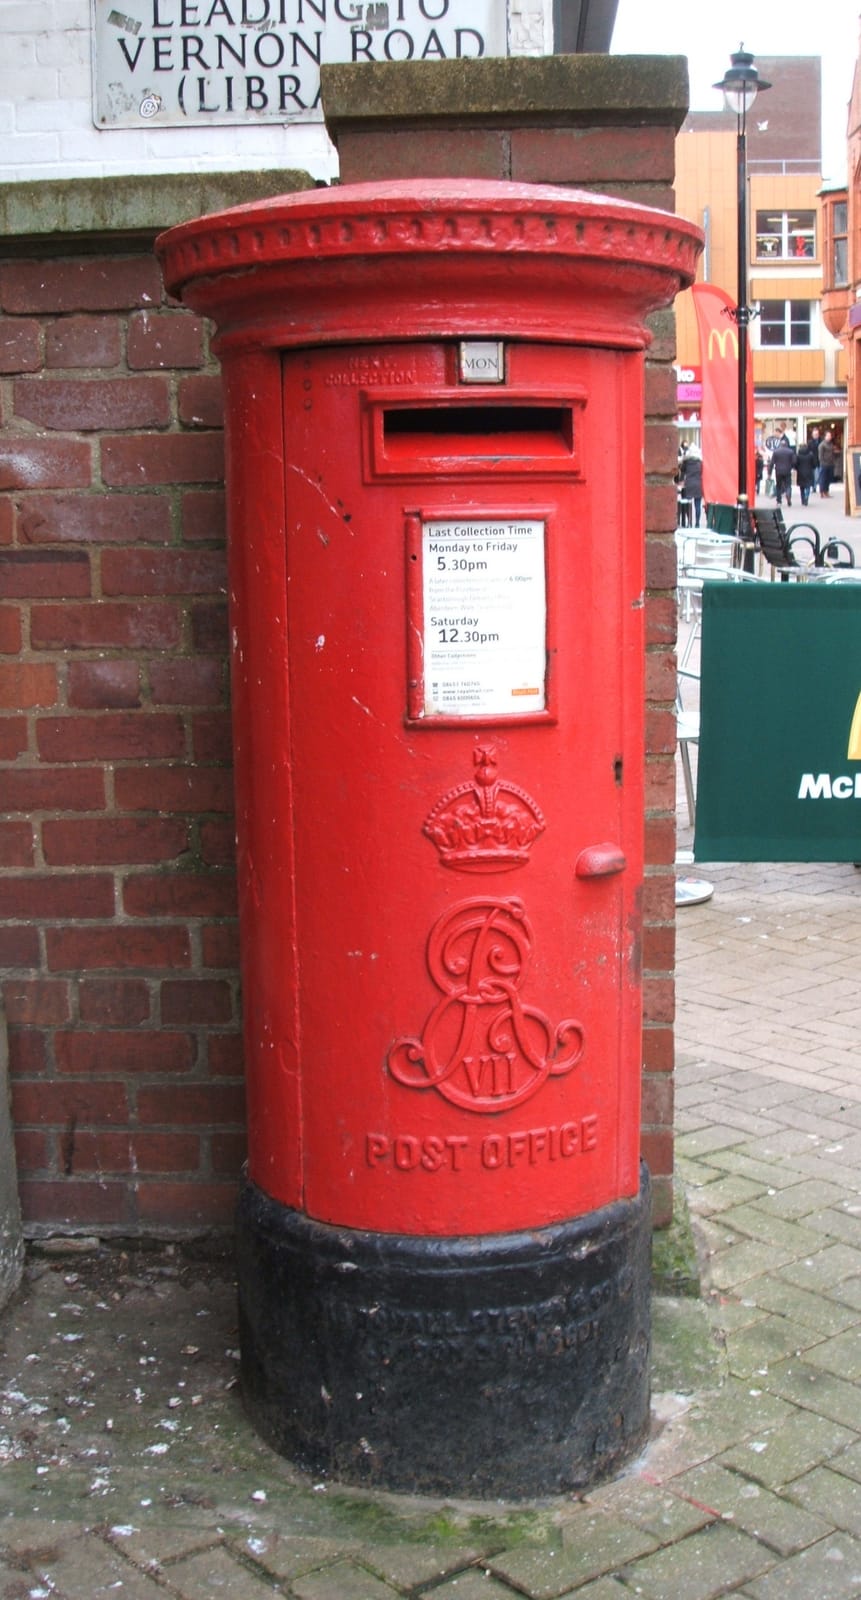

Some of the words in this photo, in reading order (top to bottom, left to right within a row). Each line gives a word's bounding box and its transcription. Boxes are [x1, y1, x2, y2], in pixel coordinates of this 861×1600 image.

[152, 0, 364, 28] LEADING
[117, 31, 321, 73] VERNON
[350, 28, 485, 61] ROAD
[463, 357, 499, 370] MON
[326, 369, 417, 386] COLLECTION
[789, 399, 831, 409] Edinburgh
[428, 527, 451, 538] Last
[454, 526, 505, 537] Collection
[508, 525, 533, 535] Time
[429, 543, 471, 555] Monday
[472, 543, 483, 552] to
[486, 542, 518, 554] Friday
[437, 556, 488, 573] 5.30pm
[431, 616, 479, 628] Saturday
[438, 628, 500, 645] 12.30pm
[365, 1131, 468, 1172] POST
[480, 1113, 598, 1169] OFFICE
